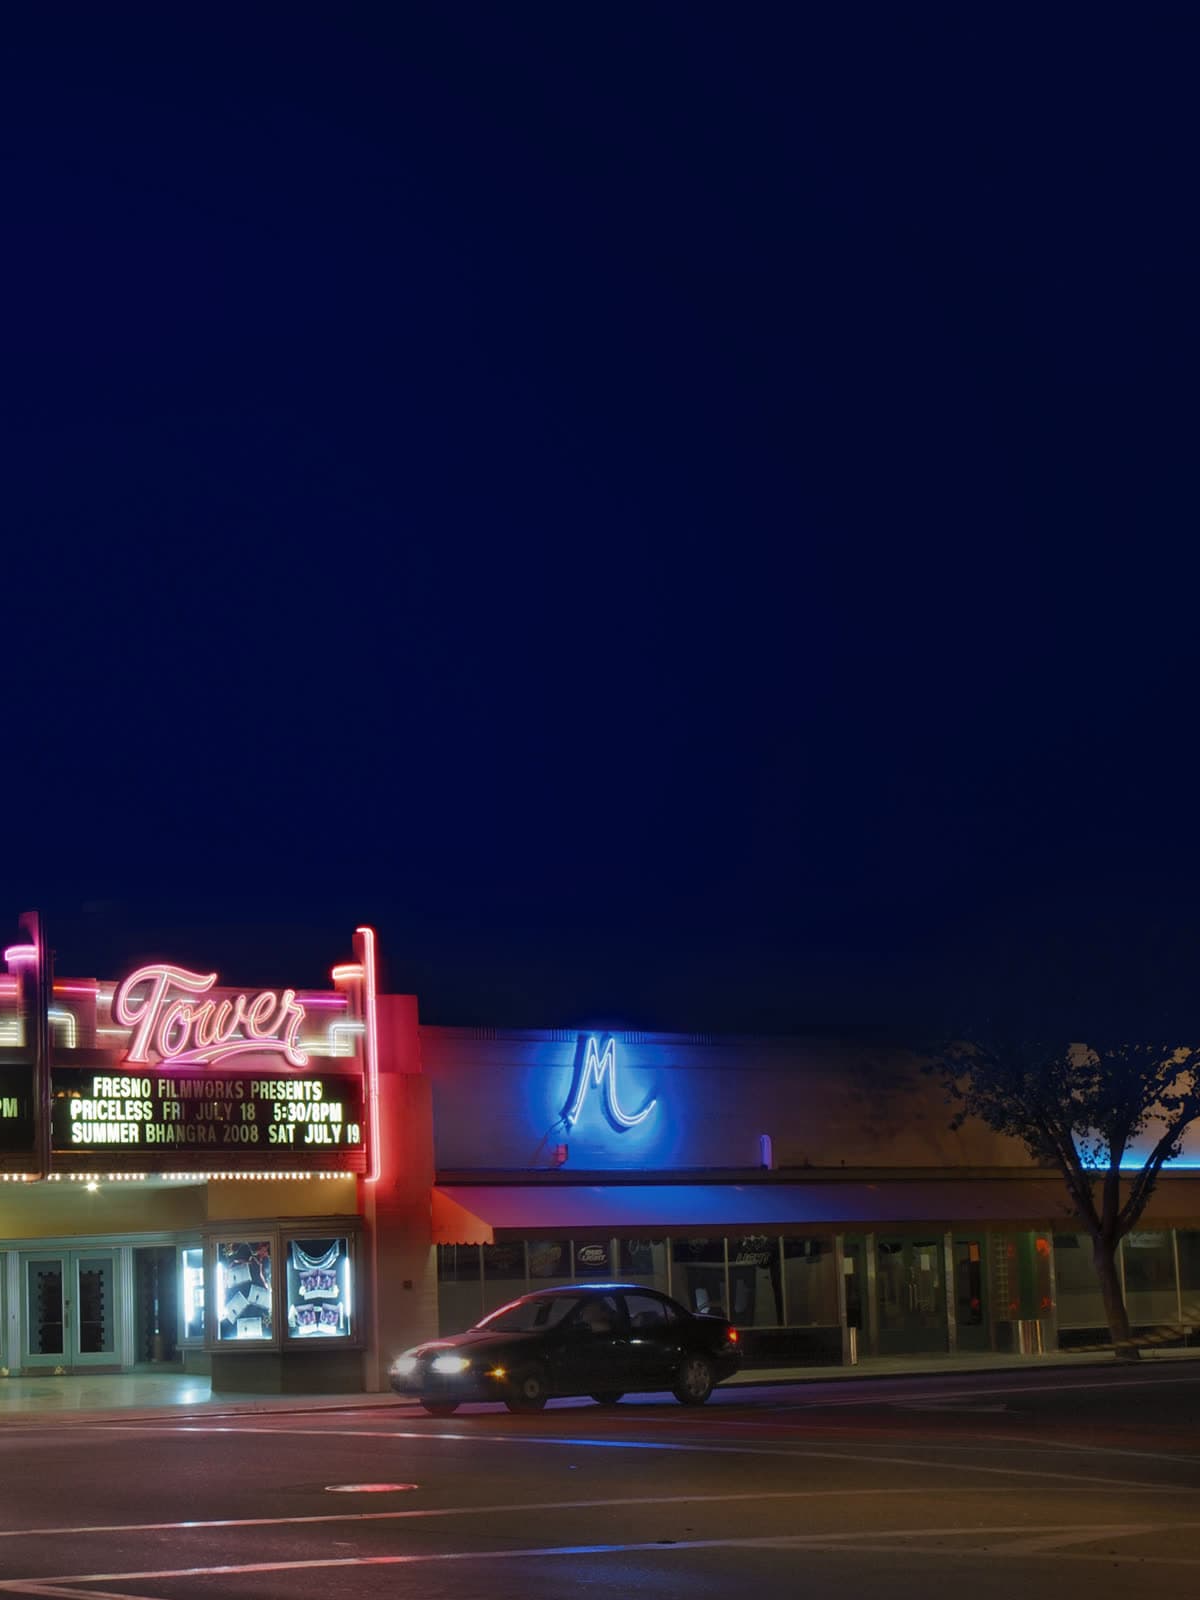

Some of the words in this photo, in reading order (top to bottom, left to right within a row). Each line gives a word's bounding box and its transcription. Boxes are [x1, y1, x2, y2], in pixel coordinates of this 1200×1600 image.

[114, 964, 309, 1067] Tower
[93, 1076, 152, 1099] FRESNO
[158, 1078, 244, 1099] FILMWORKS
[251, 1080, 323, 1101] PRESENTS
[569, 1036, 657, 1127] M
[70, 1099, 153, 1121] PRICELESS
[163, 1101, 186, 1121] FRI
[196, 1102, 232, 1121] JULY
[240, 1102, 256, 1121] 18
[273, 1102, 343, 1122] 5:30/8PM
[71, 1122, 139, 1143] SUMMER
[145, 1123, 217, 1143] BHANGRA
[223, 1124, 259, 1143] 2008
[268, 1123, 296, 1144] SAT
[304, 1124, 343, 1144] JULY
[347, 1124, 361, 1144] 19
